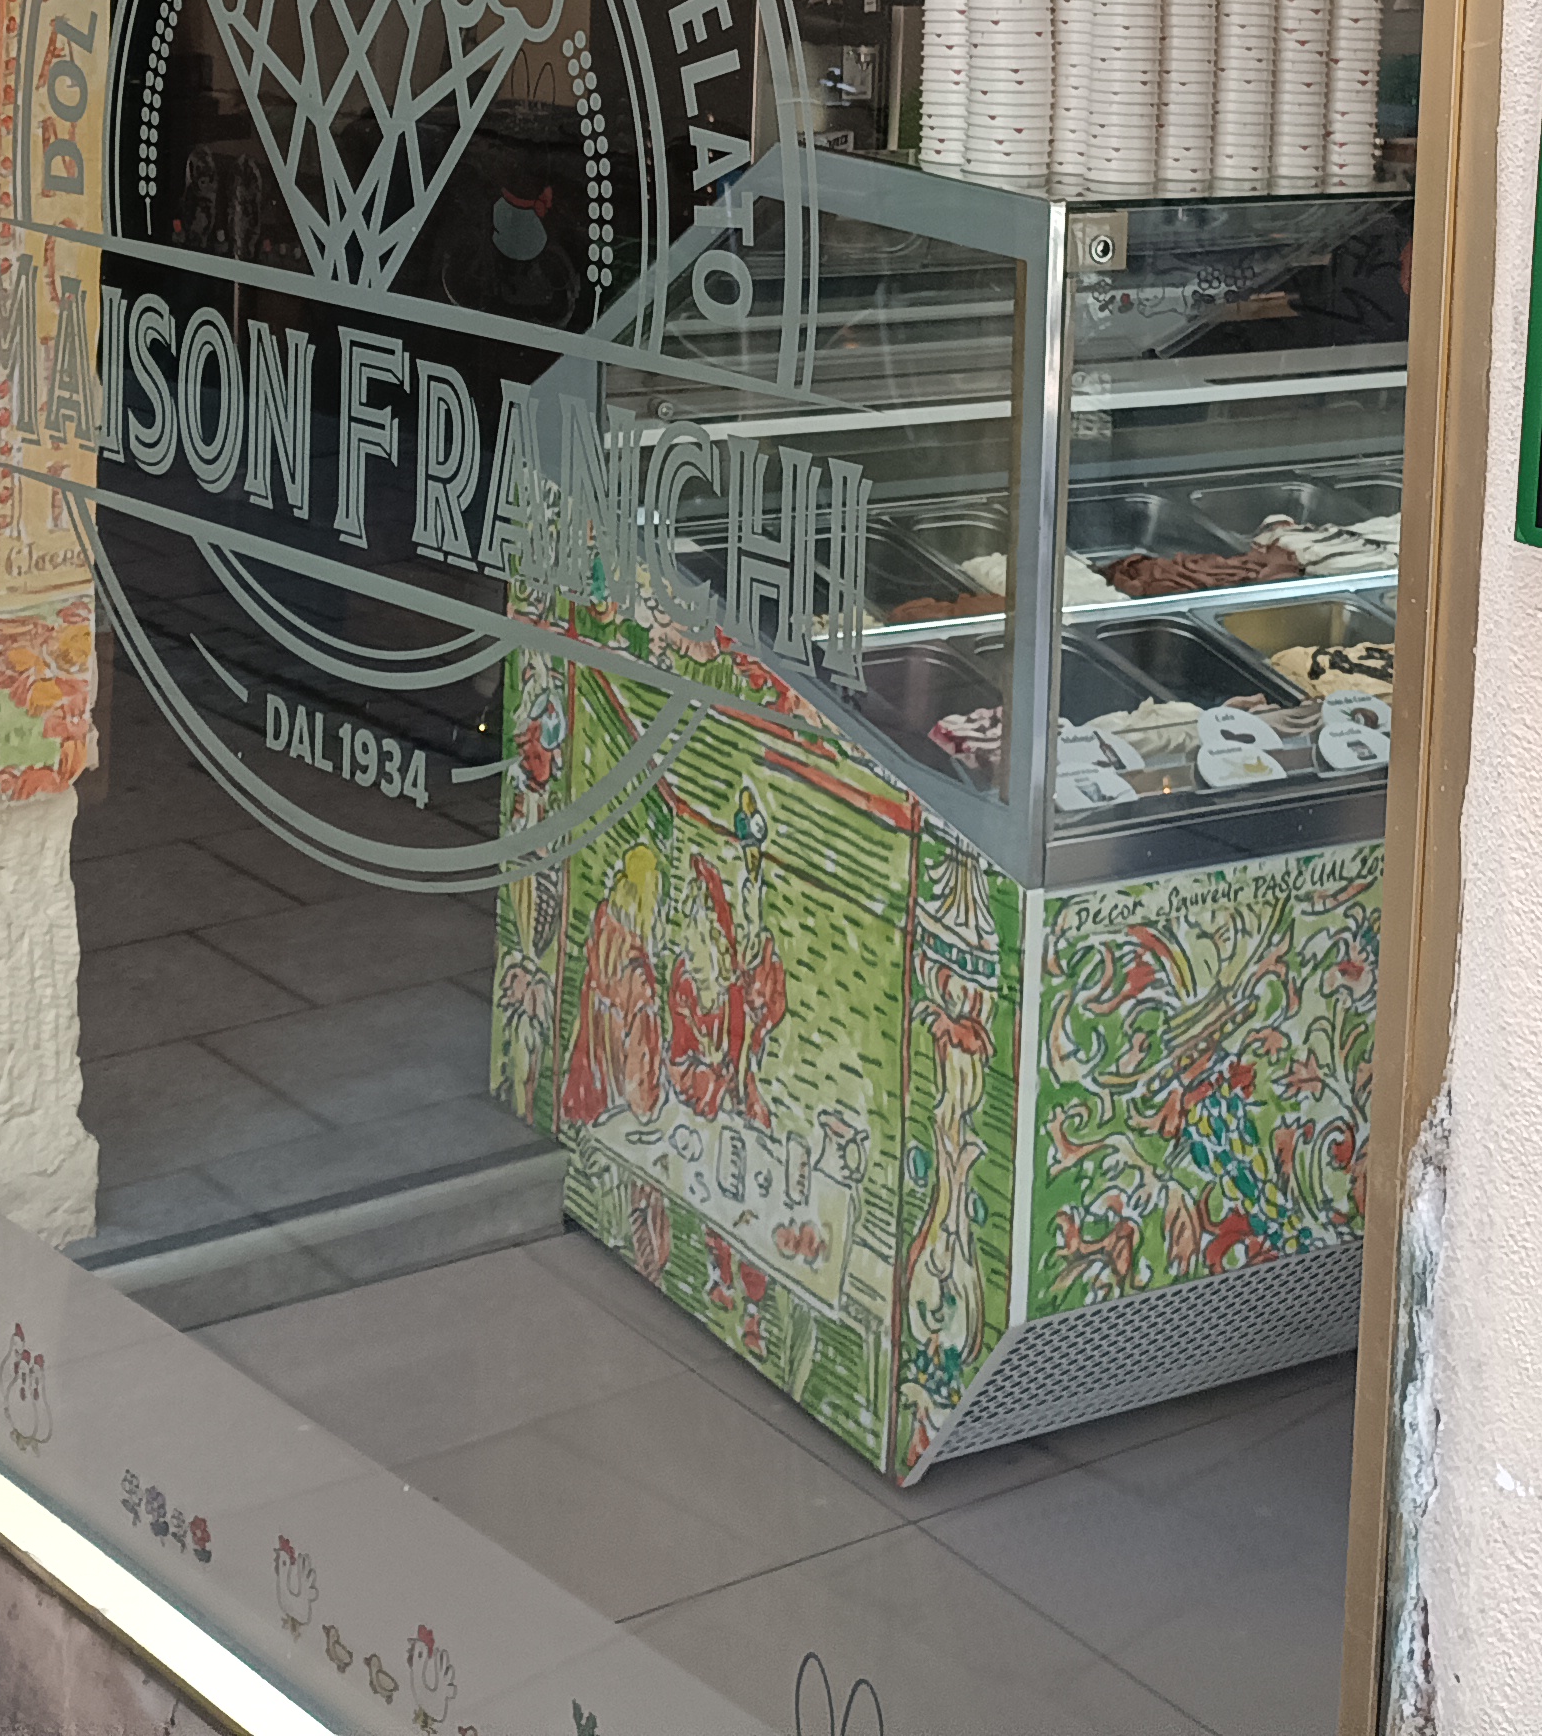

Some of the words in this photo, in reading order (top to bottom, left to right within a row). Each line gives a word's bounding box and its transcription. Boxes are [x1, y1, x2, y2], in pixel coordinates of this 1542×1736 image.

[333, 326, 871, 692] FRANCHI
[266, 694, 335, 774] DAL
[338, 714, 429, 809] 1934
